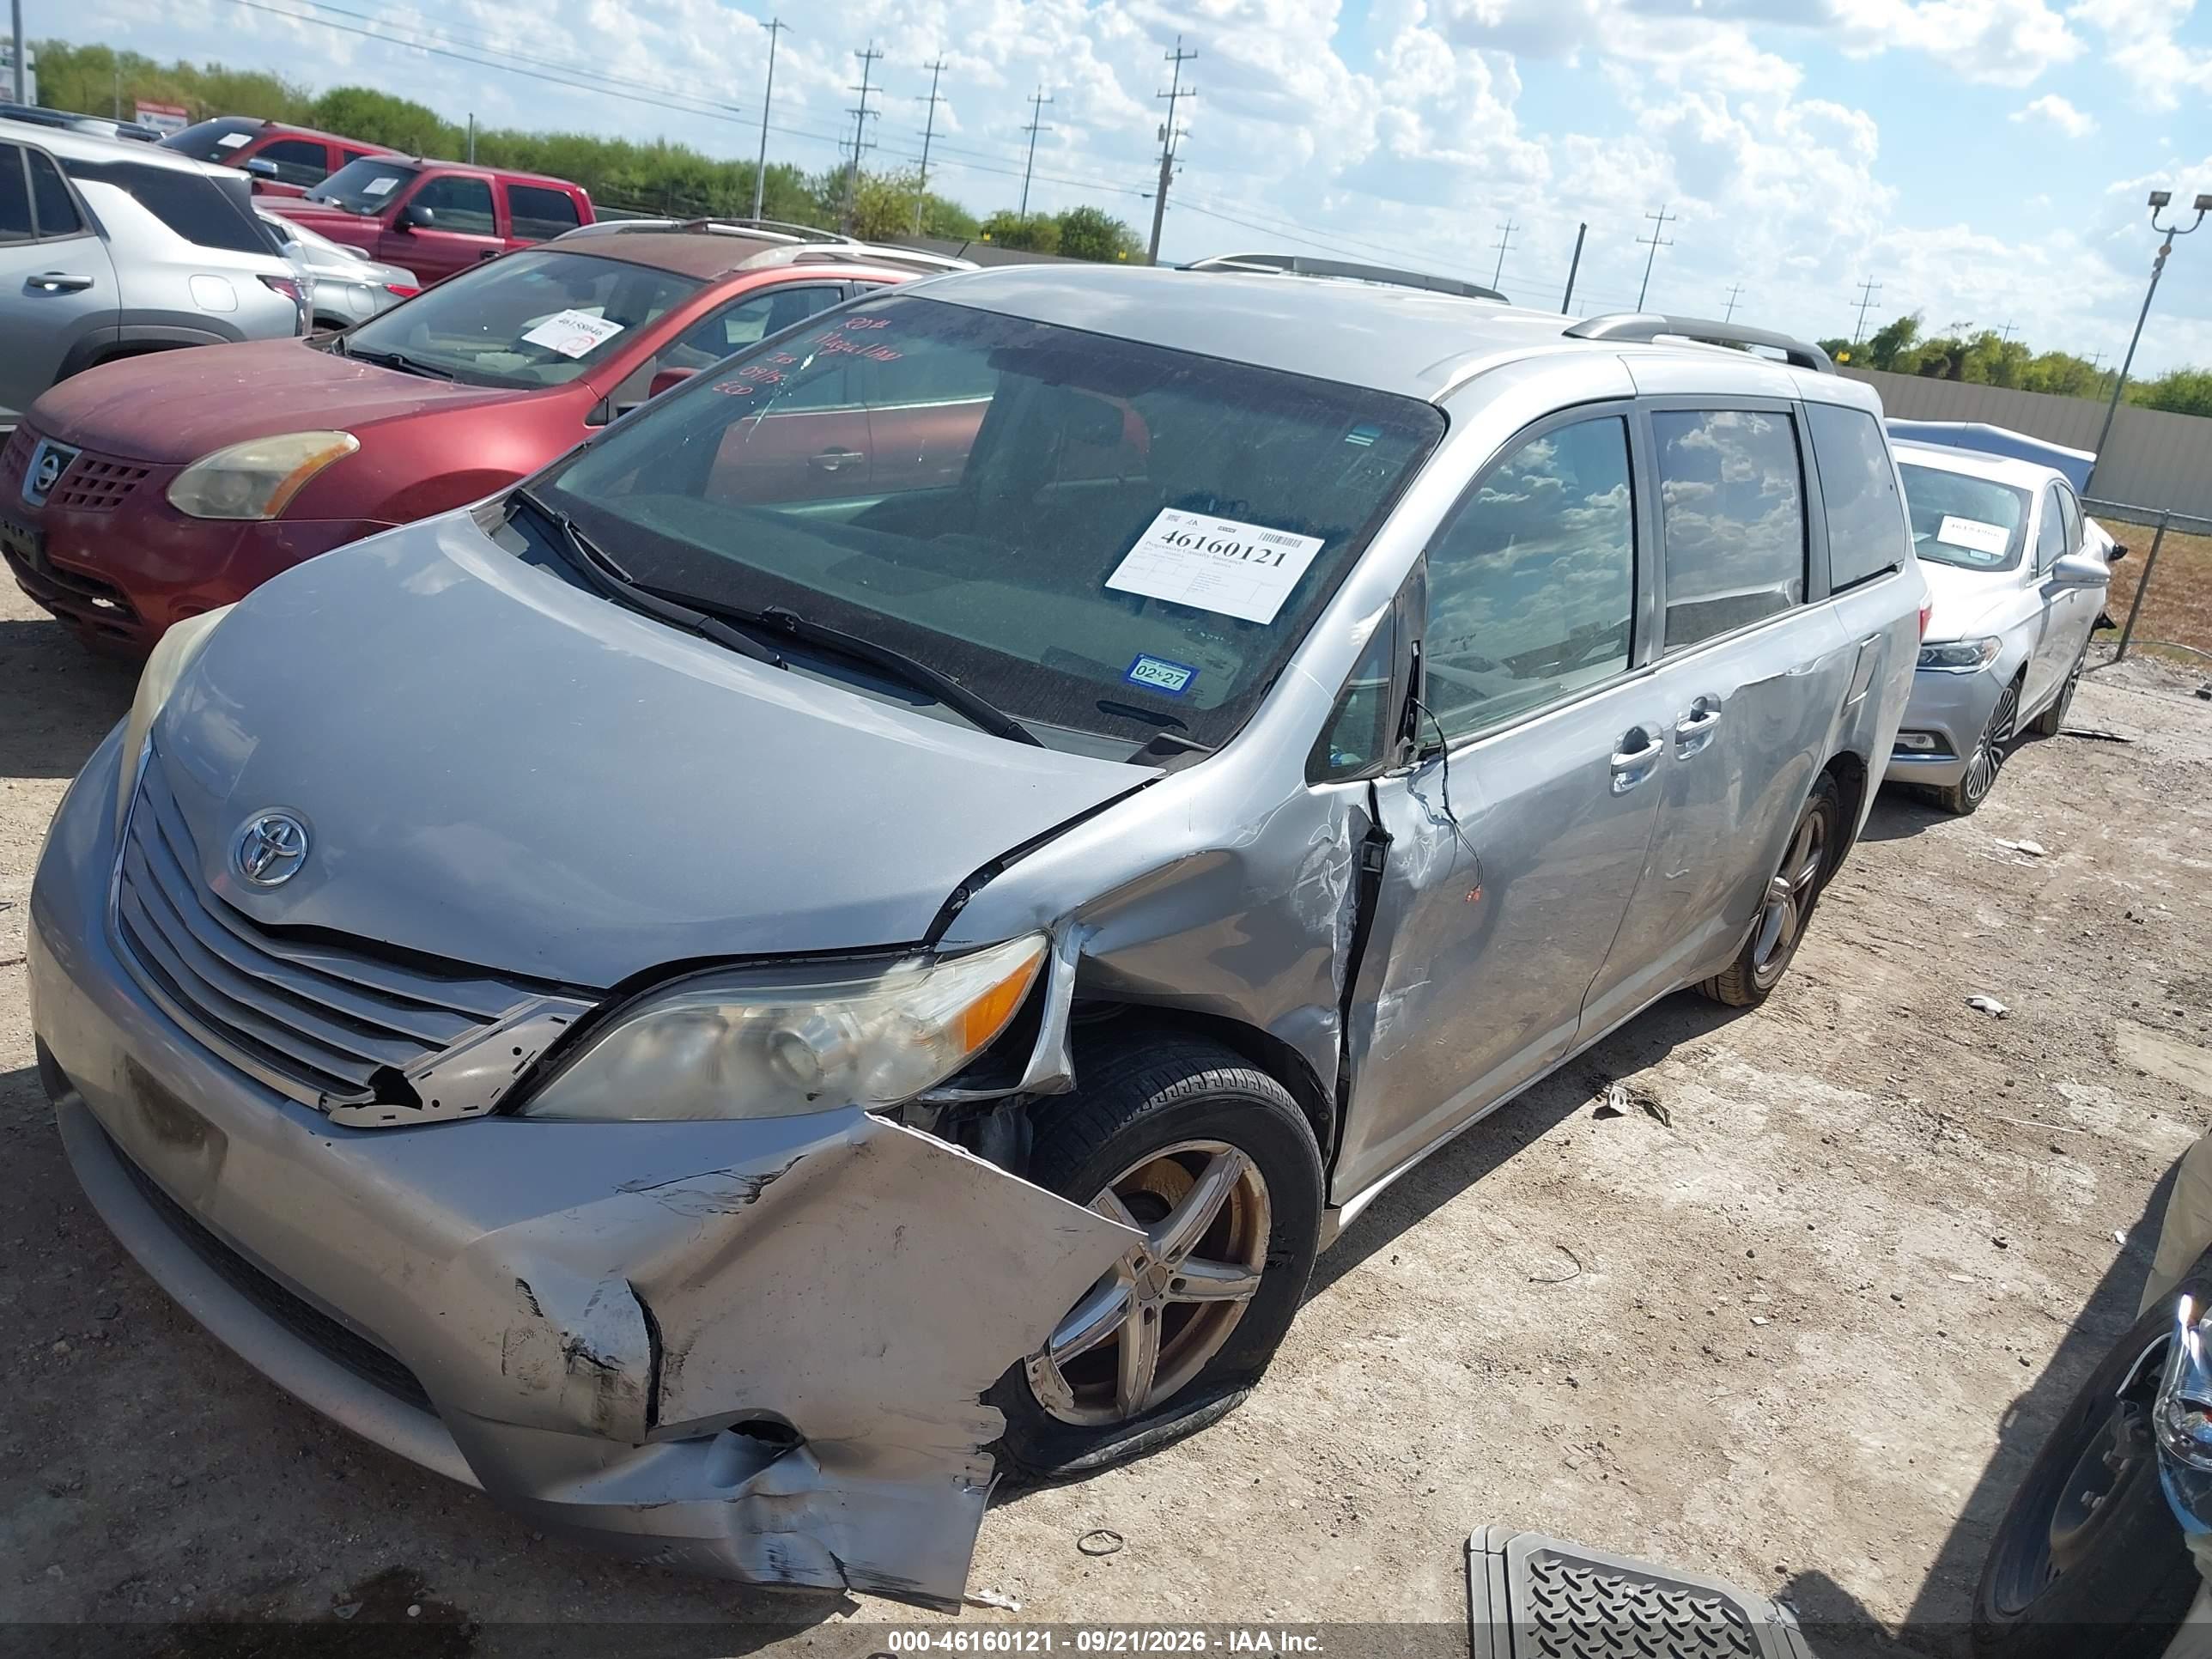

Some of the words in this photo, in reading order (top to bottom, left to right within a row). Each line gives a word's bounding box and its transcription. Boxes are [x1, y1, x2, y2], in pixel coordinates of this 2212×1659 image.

[1161, 530, 1286, 568] 46160121
[1135, 665, 1158, 679] 02
[1161, 672, 1184, 685] 27
